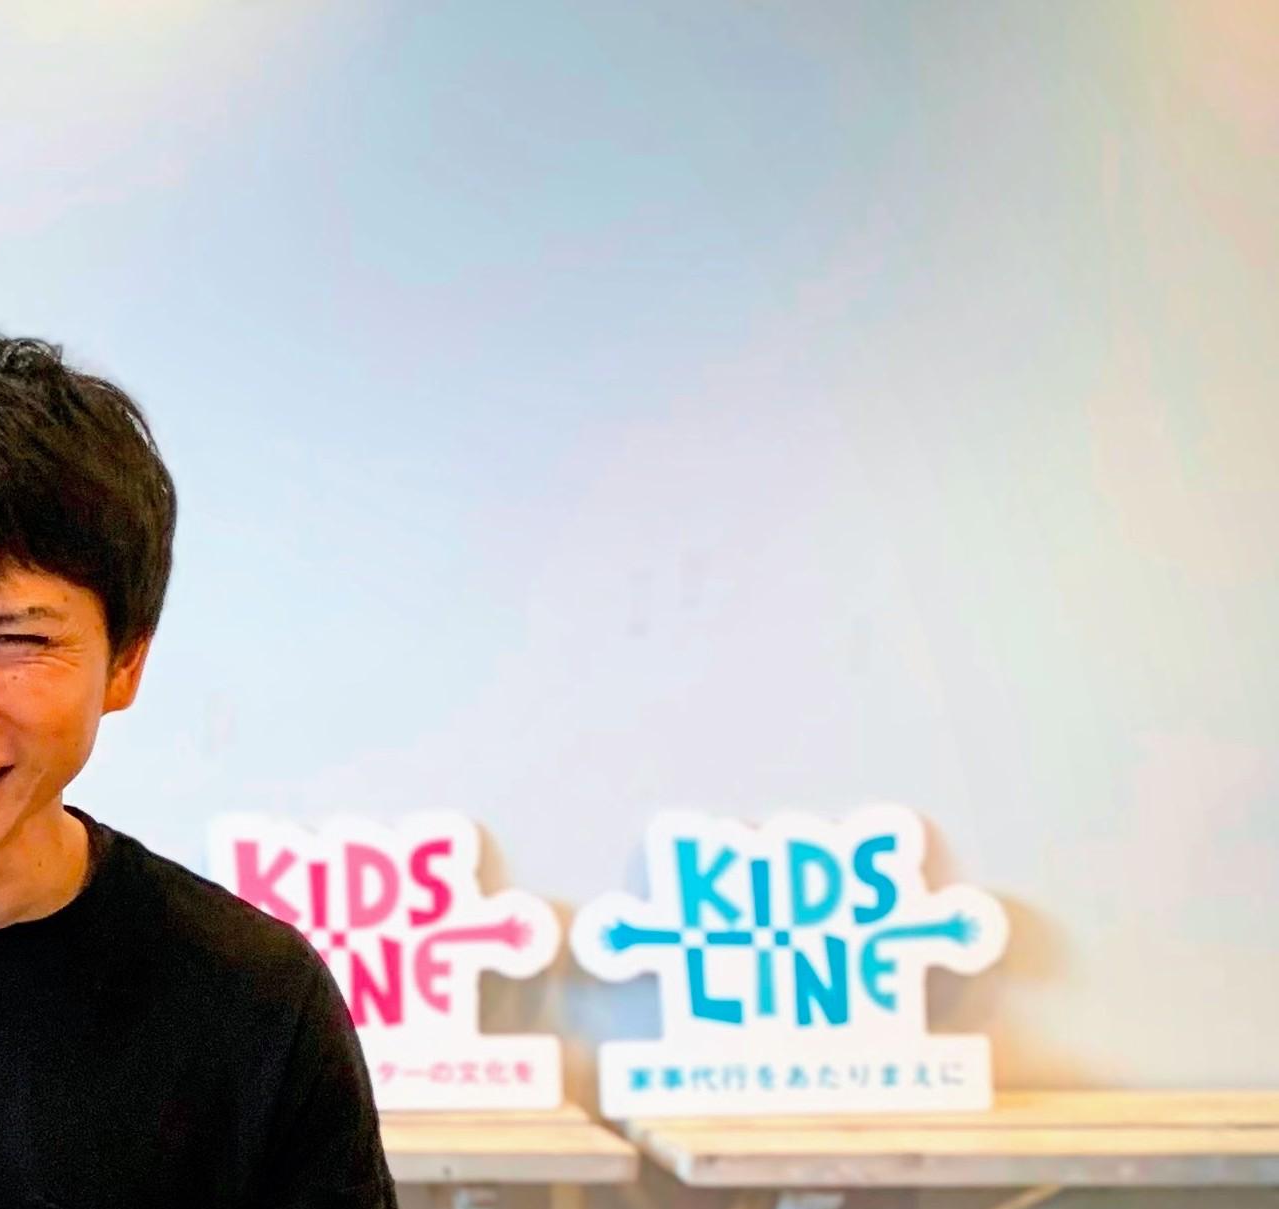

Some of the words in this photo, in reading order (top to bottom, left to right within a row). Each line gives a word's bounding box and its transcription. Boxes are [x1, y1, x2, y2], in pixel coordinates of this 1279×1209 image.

[234, 839, 453, 929] KIDS
[674, 834, 898, 927] KIDS
[685, 933, 898, 1028] LINE
[627, 1063, 965, 1092] 家事代行をあたりまえに
